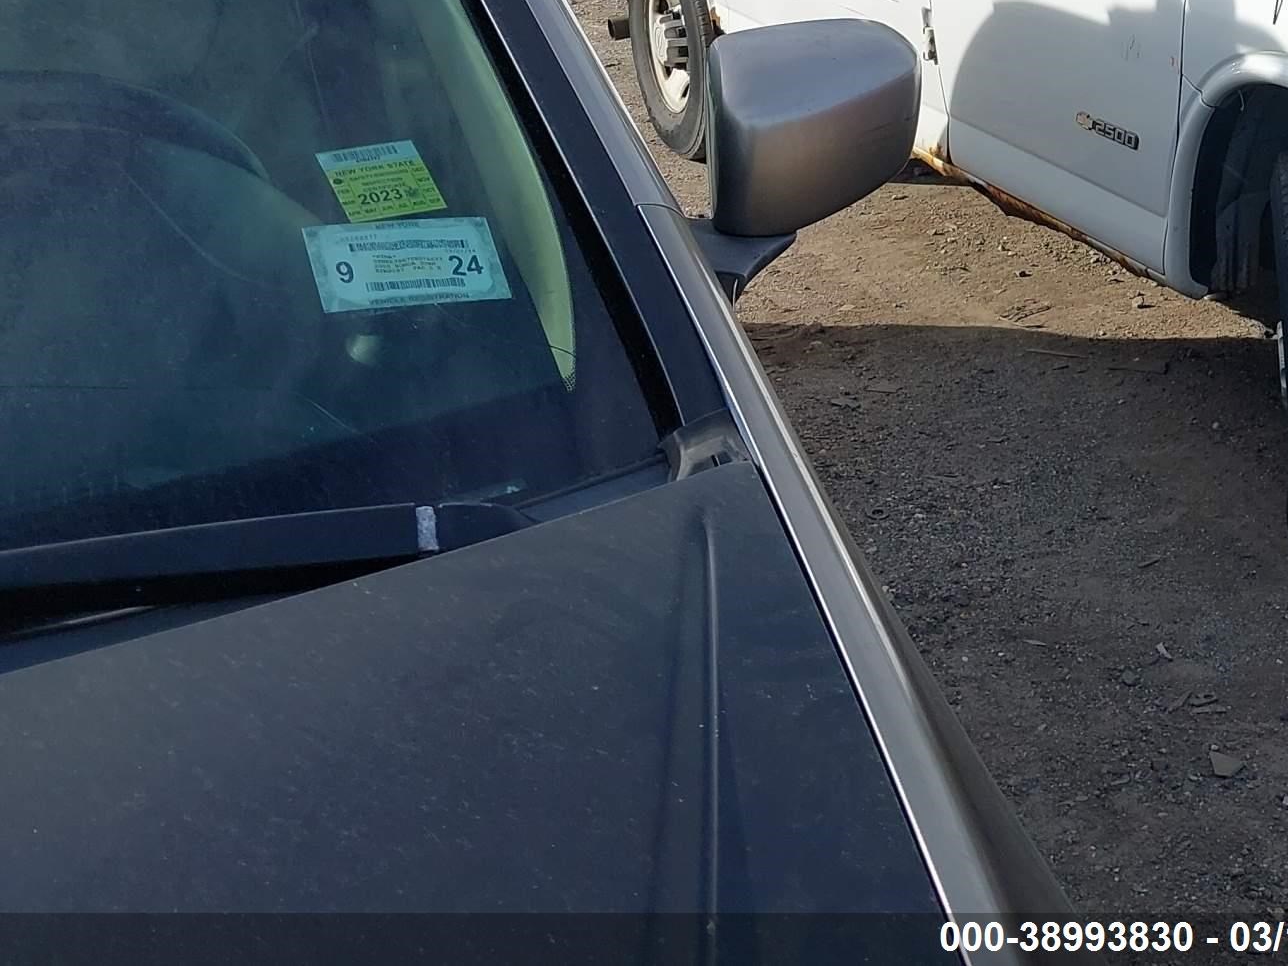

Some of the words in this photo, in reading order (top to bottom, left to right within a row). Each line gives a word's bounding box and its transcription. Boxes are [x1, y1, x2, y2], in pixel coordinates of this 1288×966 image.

[1094, 119, 1138, 149] 2500
[335, 169, 356, 177] NEW
[360, 164, 385, 172] YORK
[387, 160, 417, 170] STATE
[358, 188, 403, 205] 2023
[335, 261, 354, 284] 9
[448, 254, 484, 276] 24
